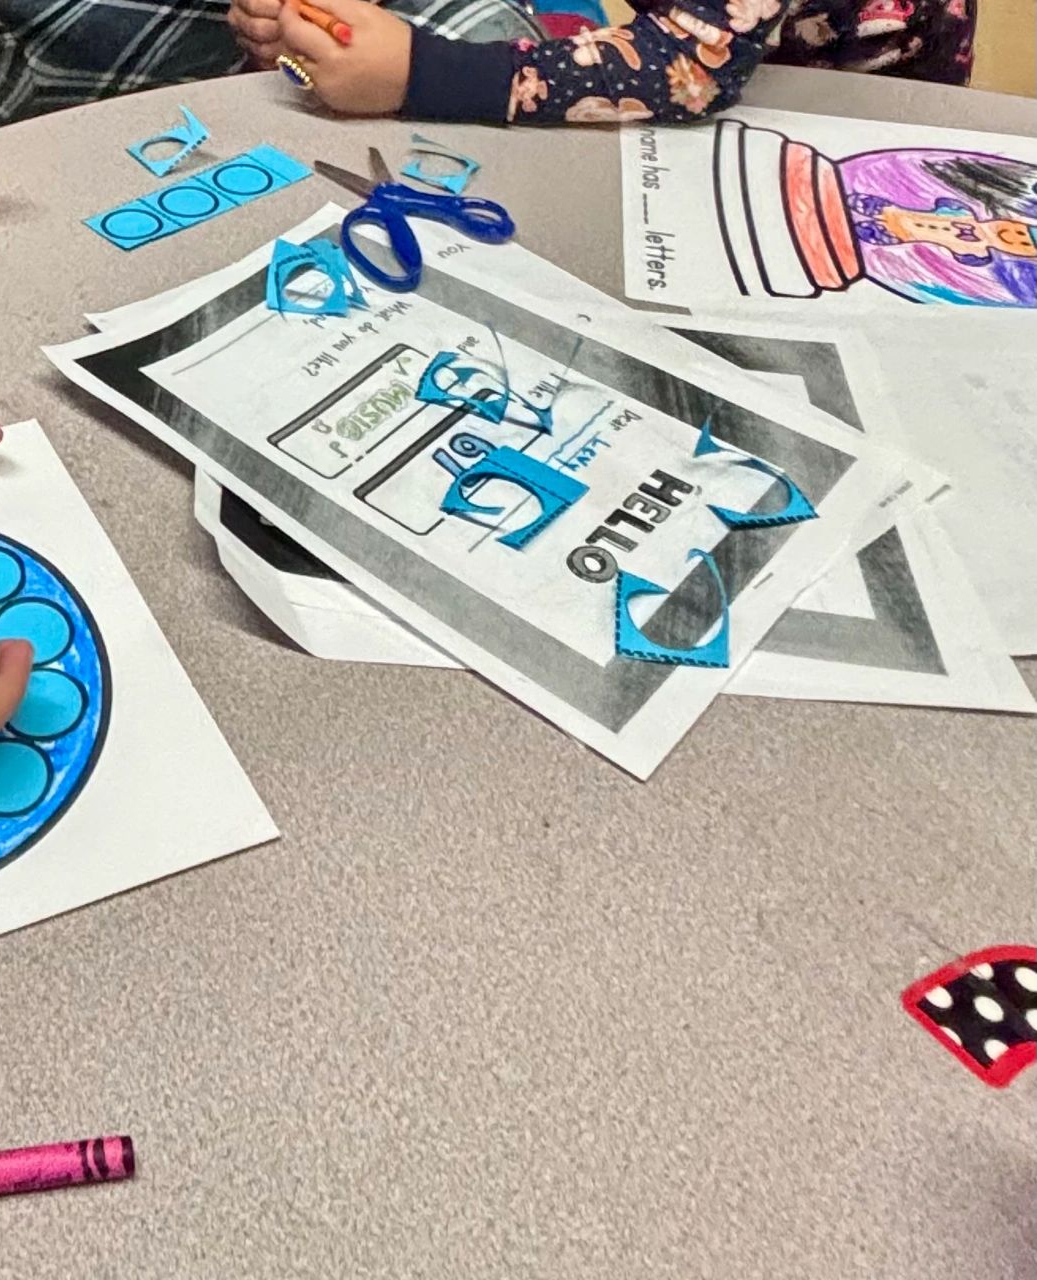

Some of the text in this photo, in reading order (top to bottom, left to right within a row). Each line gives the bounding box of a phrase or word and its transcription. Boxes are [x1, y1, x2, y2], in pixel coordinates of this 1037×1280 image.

[640, 129, 676, 291] name has letters.
[358, 322, 380, 334] do
[302, 351, 340, 377] like?
[554, 436, 611, 470] Levy
[566, 469, 694, 584] HELLO
